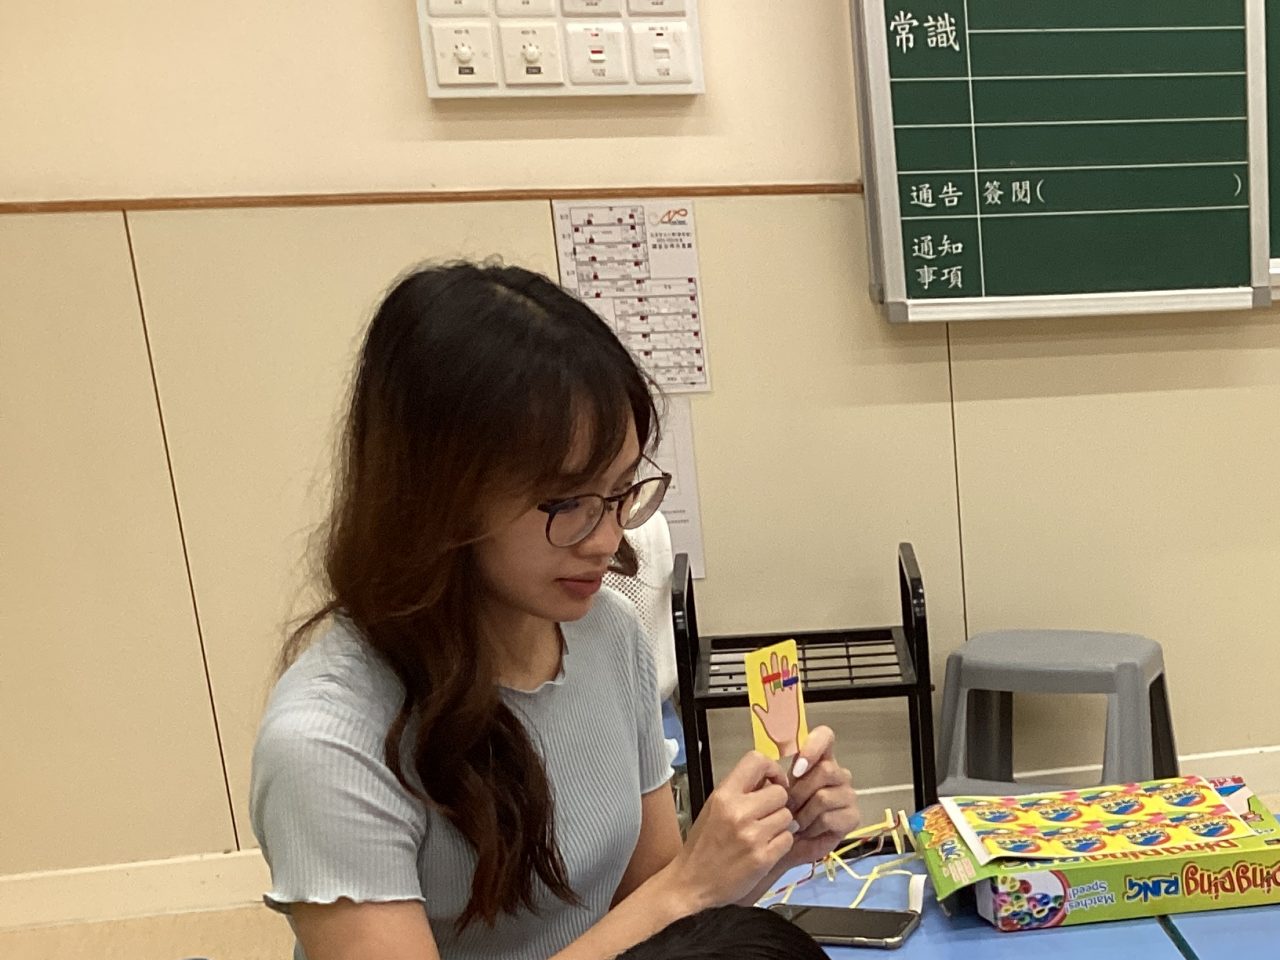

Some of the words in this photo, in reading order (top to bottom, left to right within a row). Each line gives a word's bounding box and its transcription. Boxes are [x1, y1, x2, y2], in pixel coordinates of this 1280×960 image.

[890, 11, 960, 53] 常識
[910, 181, 963, 207] 通告
[912, 234, 963, 260] 通知
[916, 265, 962, 290] 事項
